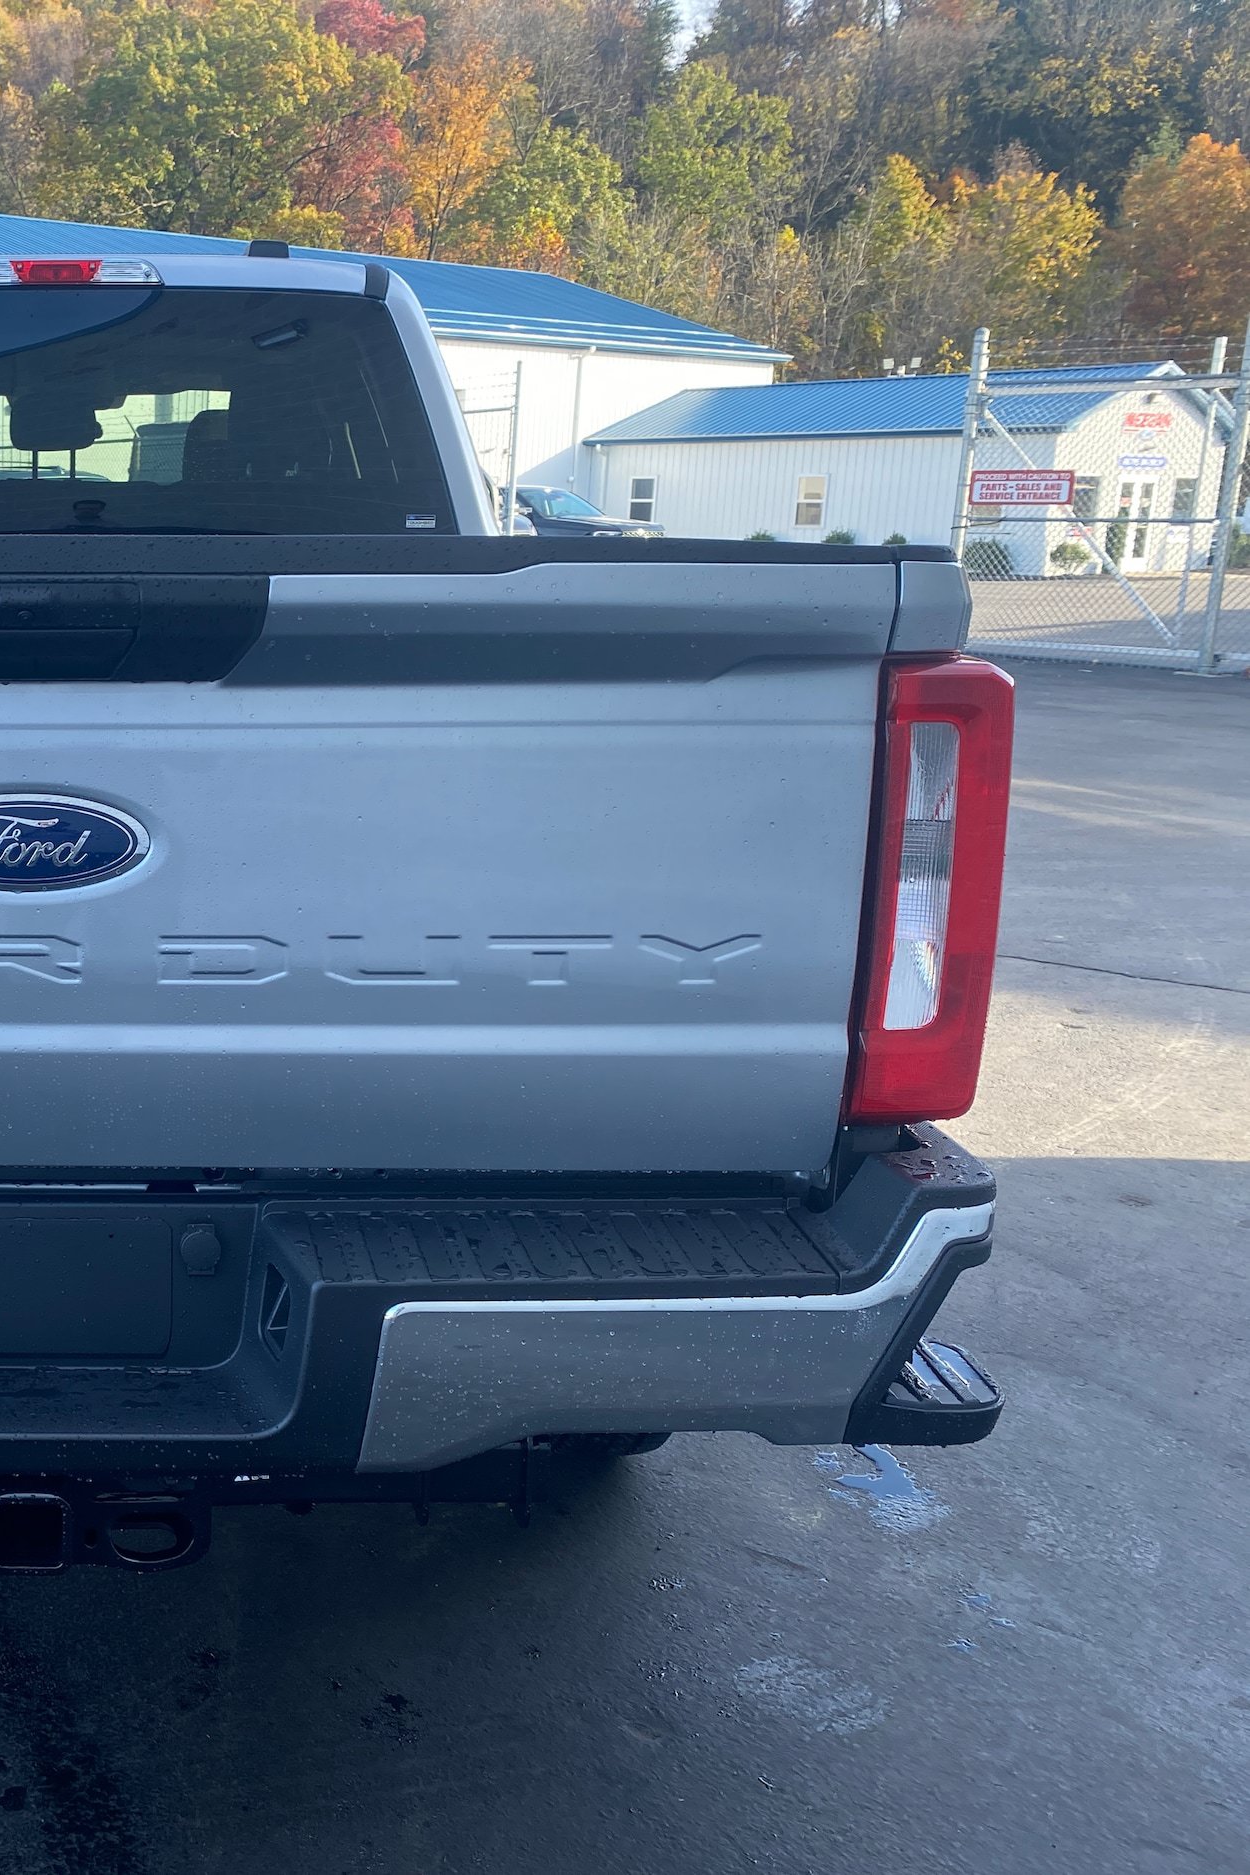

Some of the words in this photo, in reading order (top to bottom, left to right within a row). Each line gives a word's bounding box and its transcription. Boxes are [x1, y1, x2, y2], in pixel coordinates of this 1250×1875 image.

[980, 483, 1008, 491] PARTS
[1015, 483, 1041, 491] SALES
[1043, 483, 1063, 491] AND
[979, 492, 1014, 500] SERVICE
[1017, 492, 1062, 500] ENTRANCE
[156, 932, 763, 987] DUTY
